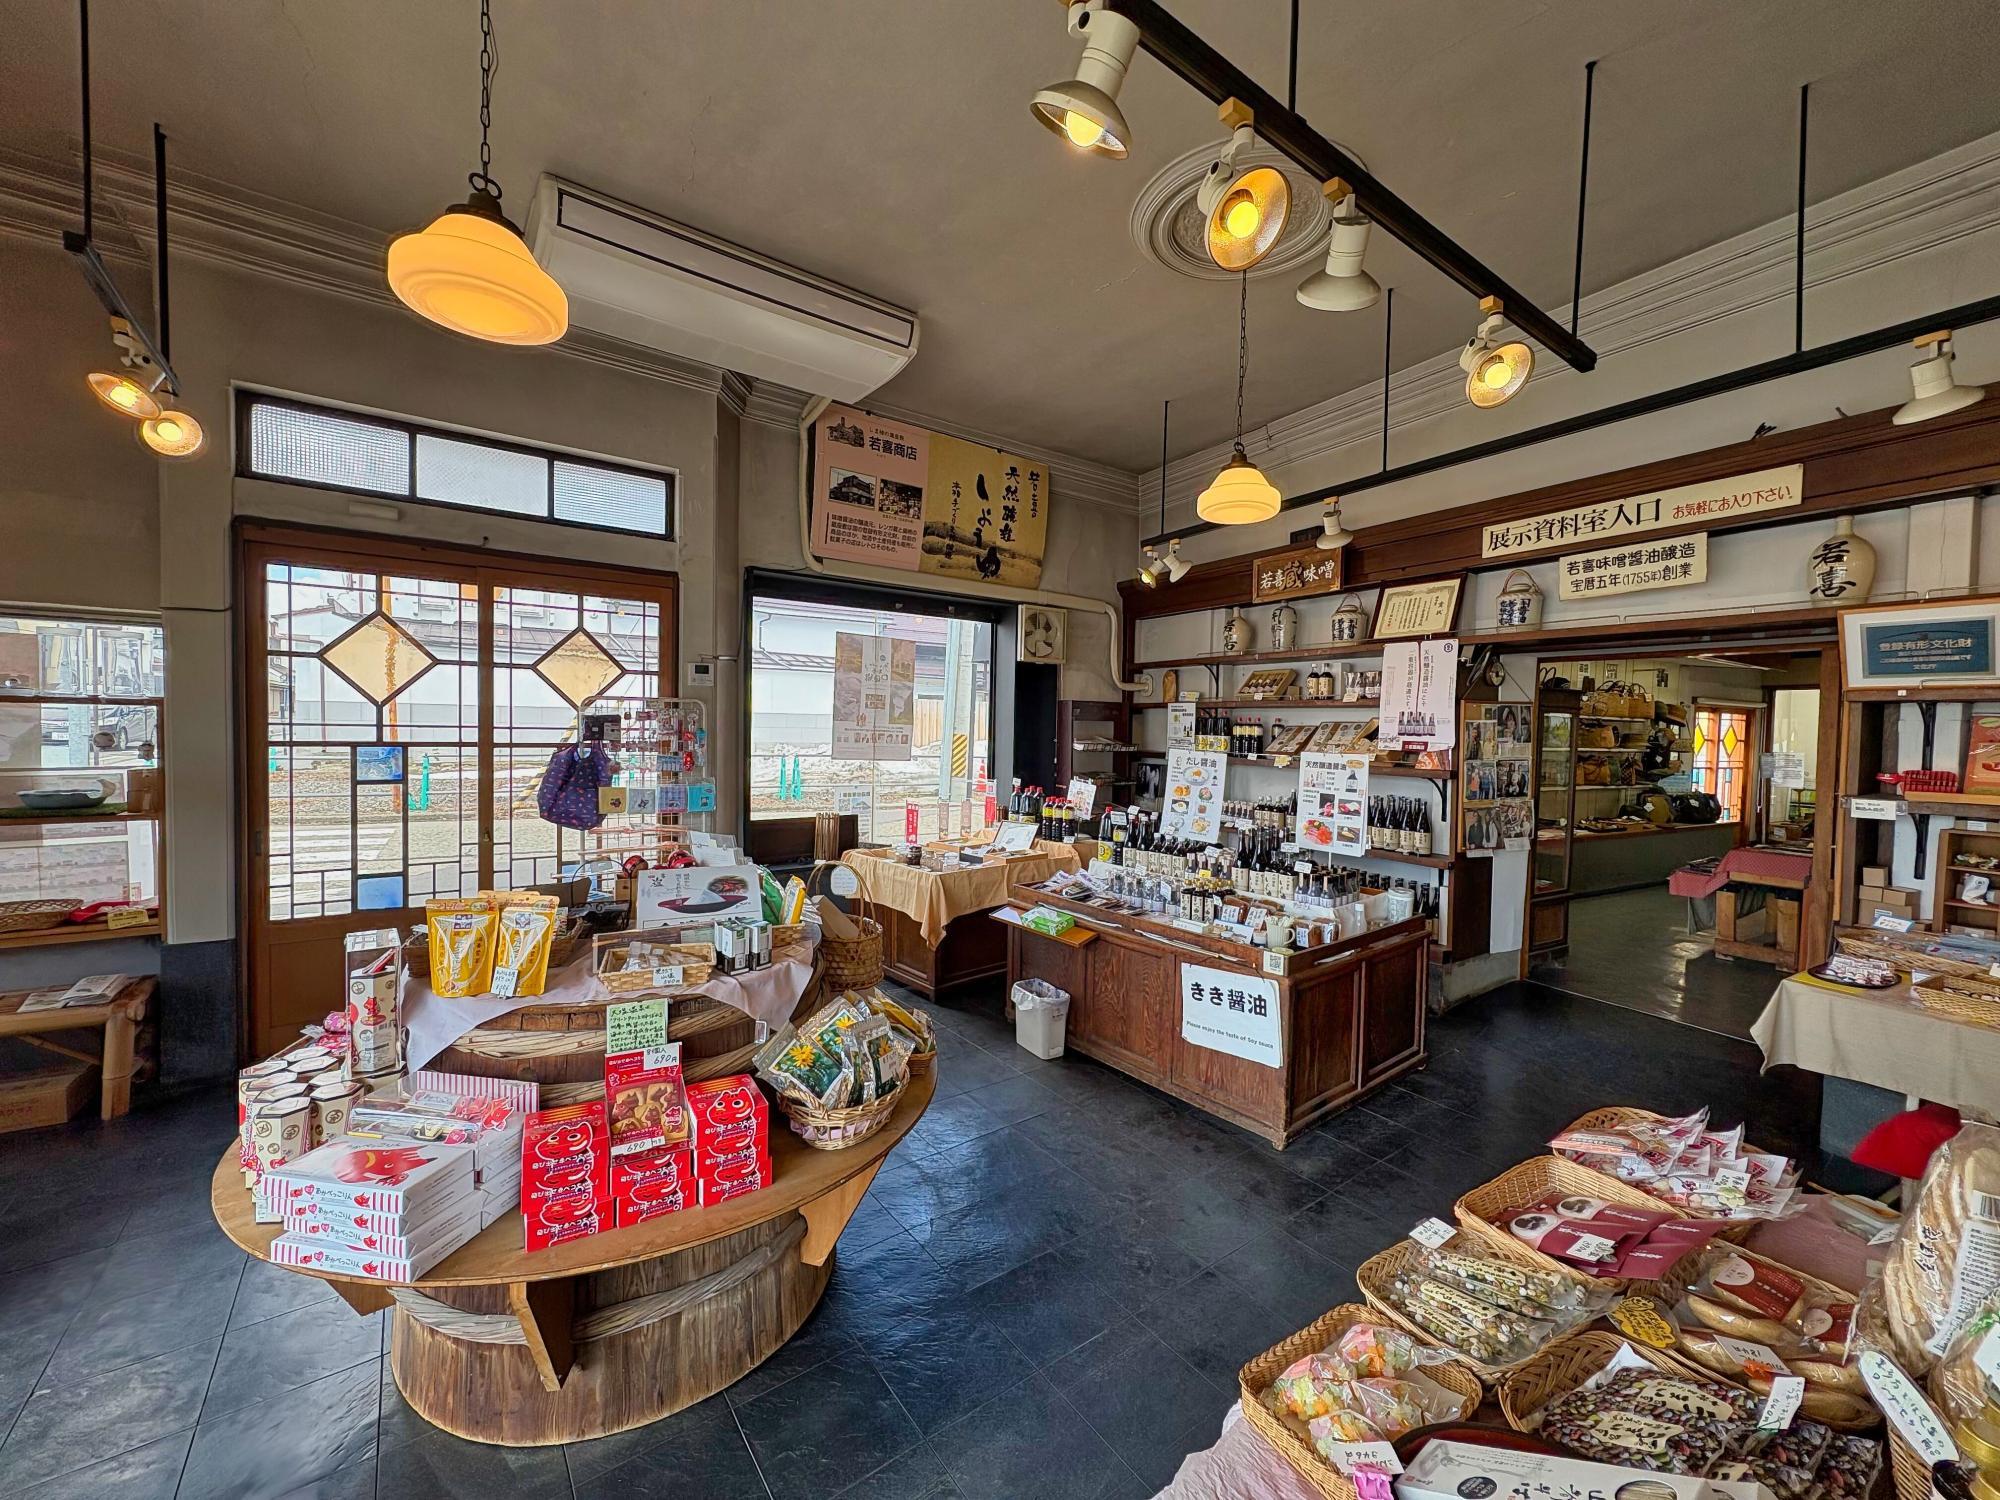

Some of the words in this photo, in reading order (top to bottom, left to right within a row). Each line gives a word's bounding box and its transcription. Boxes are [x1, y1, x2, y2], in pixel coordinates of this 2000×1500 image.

[868, 435, 918, 461] 若喜商店
[1487, 498, 1662, 551] 展示資料室入口
[1260, 559, 1335, 591] 若喜蔵味噌
[1809, 540, 1857, 597] 若喜
[1570, 561, 1693, 593] 宝暦五年(1755年)創業
[1879, 638, 1973, 652] 登録有形文化財
[1305, 760, 1347, 771] 天然醸造醤油
[1190, 981, 1268, 1018] きき醤油
[1186, 1020, 1201, 1029] Please
[1202, 1026, 1216, 1034] enjoy
[653, 1054, 678, 1065] 690円
[315, 1187, 353, 1201] あかべっこりん
[318, 1206, 353, 1221] あかべっこりん
[330, 1225, 361, 1240] あかべっこりん
[325, 1254, 361, 1269] あかべっこりん
